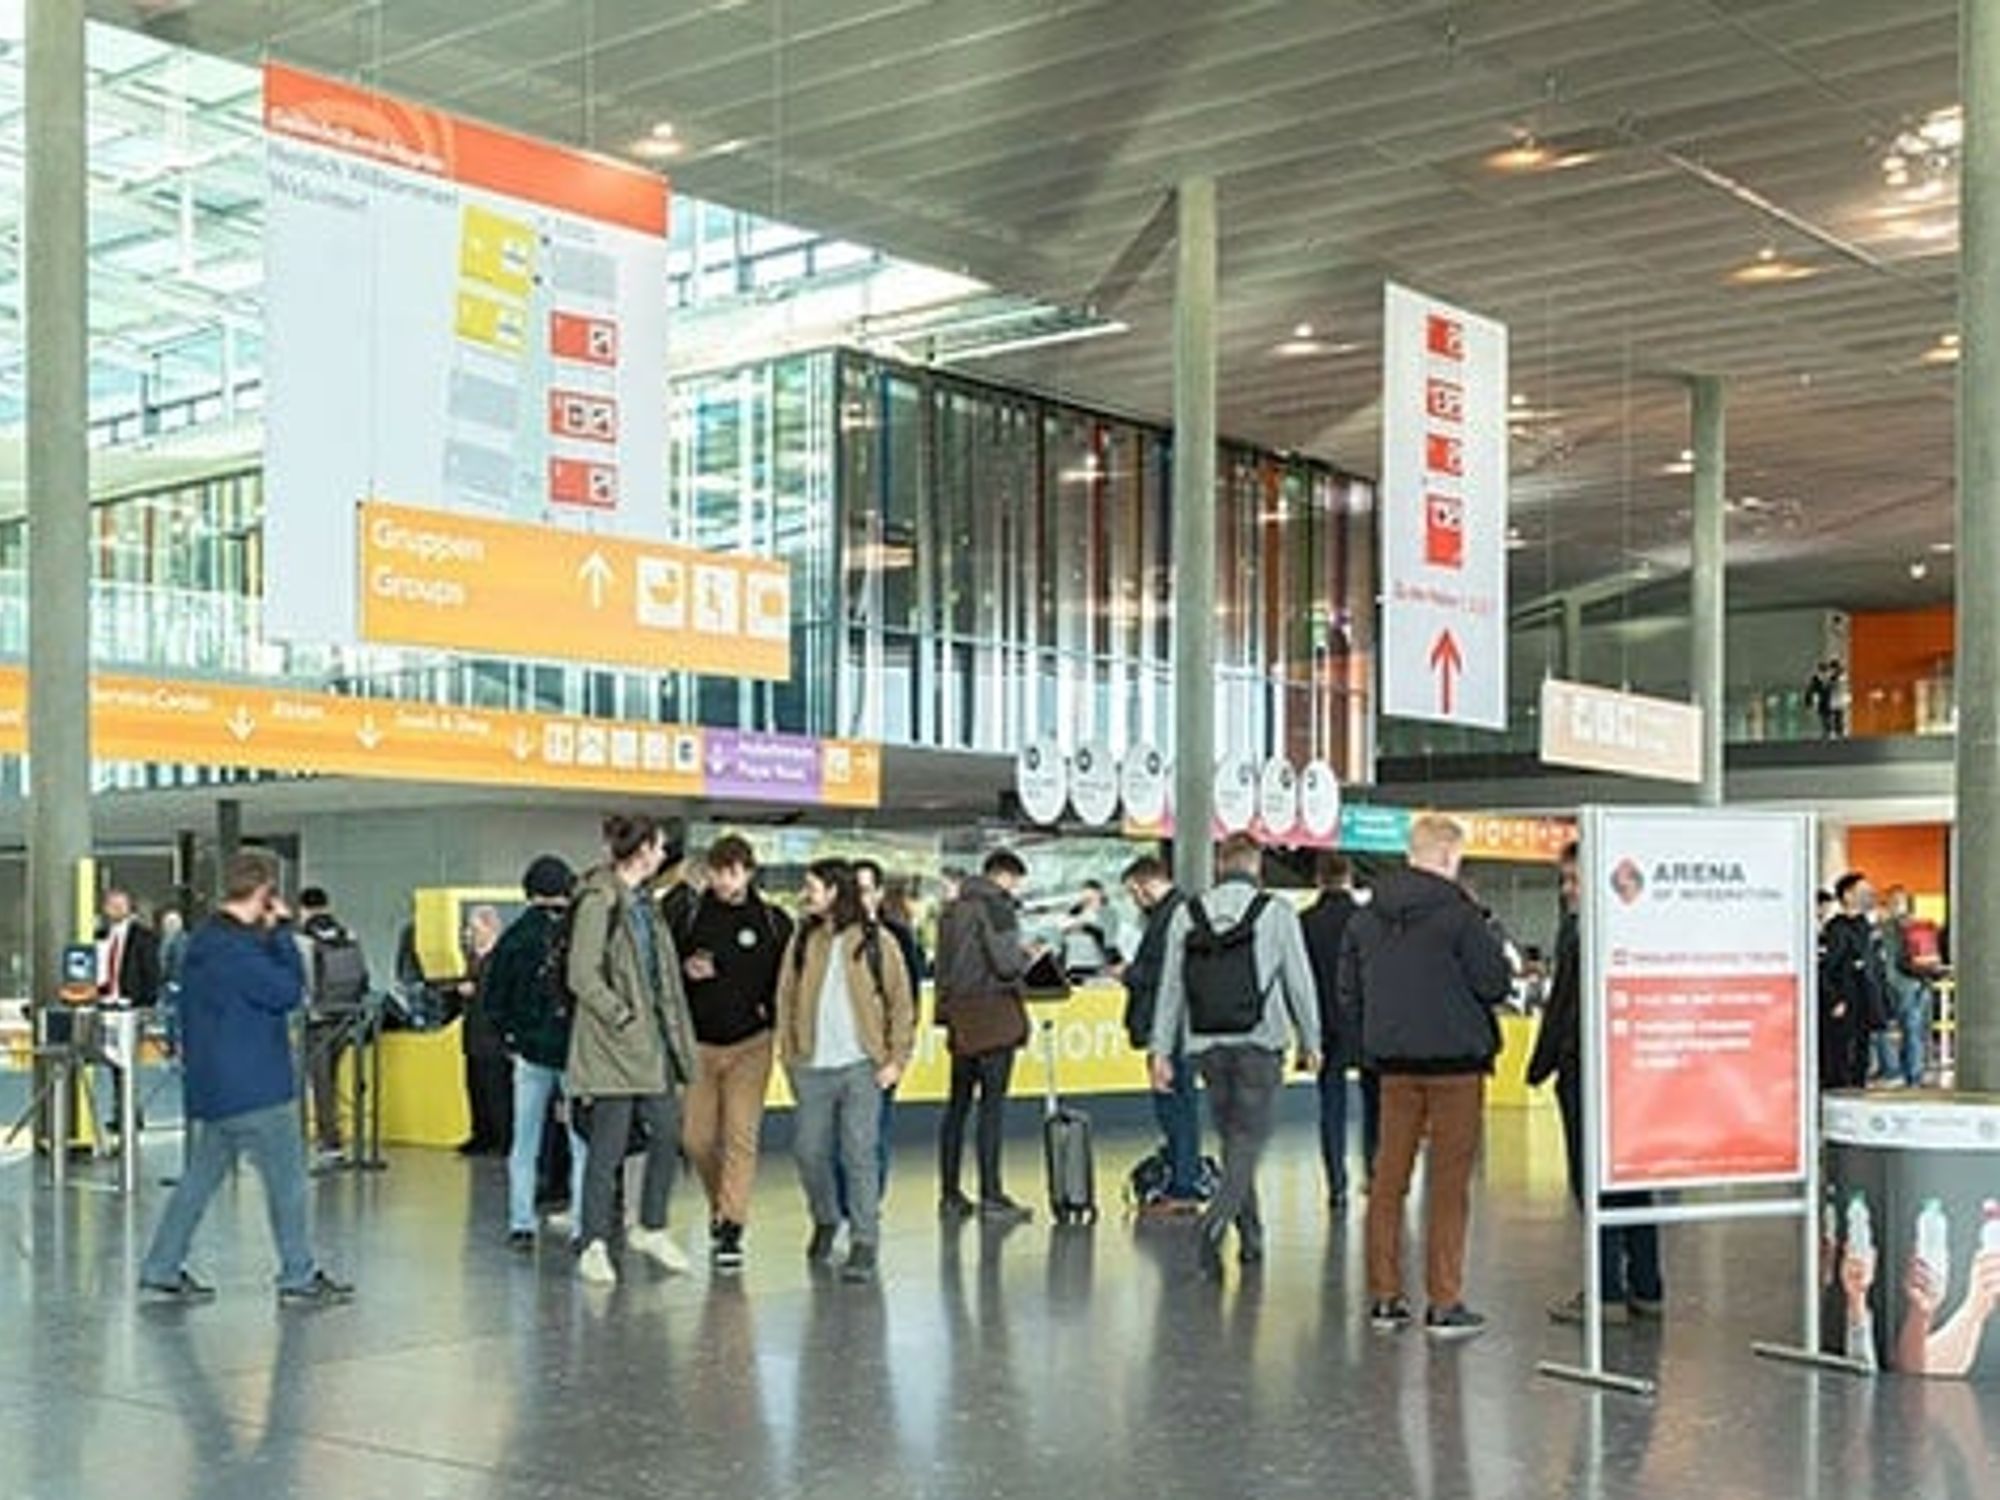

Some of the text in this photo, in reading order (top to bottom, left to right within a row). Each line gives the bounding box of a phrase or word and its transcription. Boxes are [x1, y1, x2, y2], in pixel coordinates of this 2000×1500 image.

[370, 518, 485, 564] Gruppen
[370, 564, 465, 610] Groups
[1652, 863, 1747, 883] ARENA
